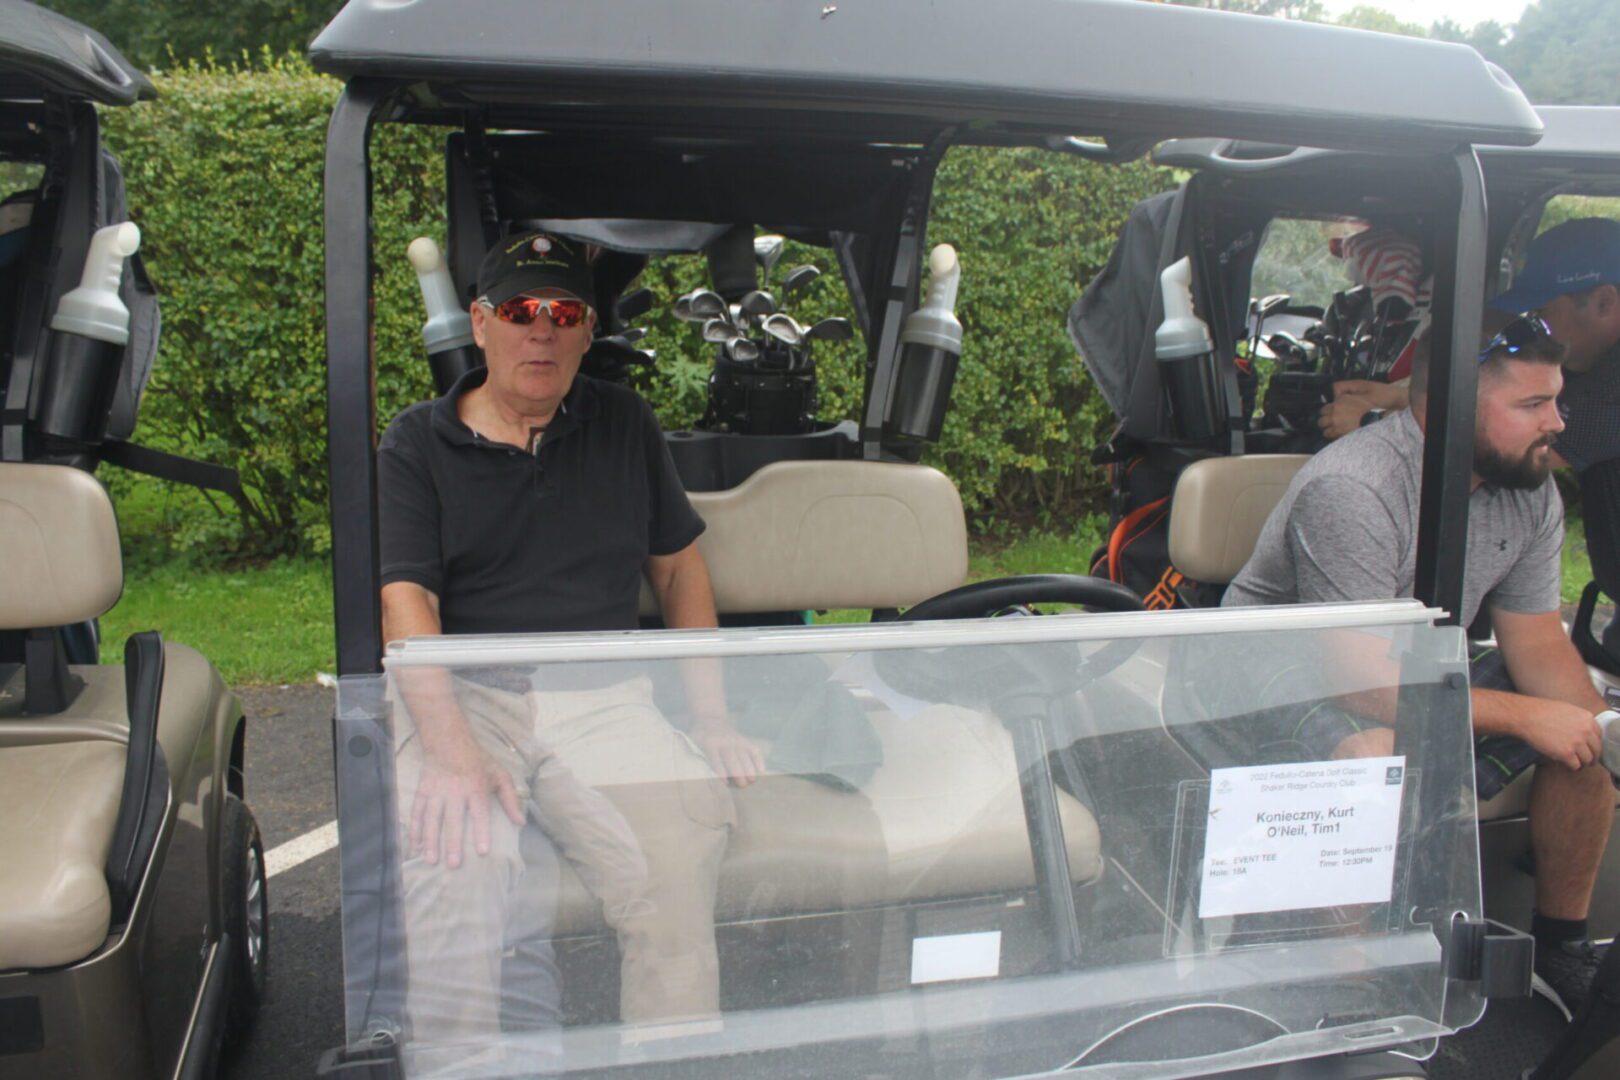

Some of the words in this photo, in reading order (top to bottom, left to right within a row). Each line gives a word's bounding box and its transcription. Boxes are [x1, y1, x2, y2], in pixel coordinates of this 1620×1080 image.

[1250, 772, 1268, 782] 2022
[1327, 768, 1340, 777] Golf
[1341, 767, 1368, 776] Classic
[1260, 783, 1285, 793] Shaker
[1287, 781, 1308, 791] Ridge
[1309, 780, 1337, 790] Country
[1339, 779, 1356, 787] Club
[1256, 810, 1324, 824] Konieczny,
[1328, 806, 1355, 818] Kurt
[1267, 824, 1308, 838] O'Neil,
[1312, 822, 1340, 834] Tim1
[1342, 845, 1382, 857] September
[1233, 854, 1260, 865] EVENT
[1262, 853, 1277, 862] TEE
